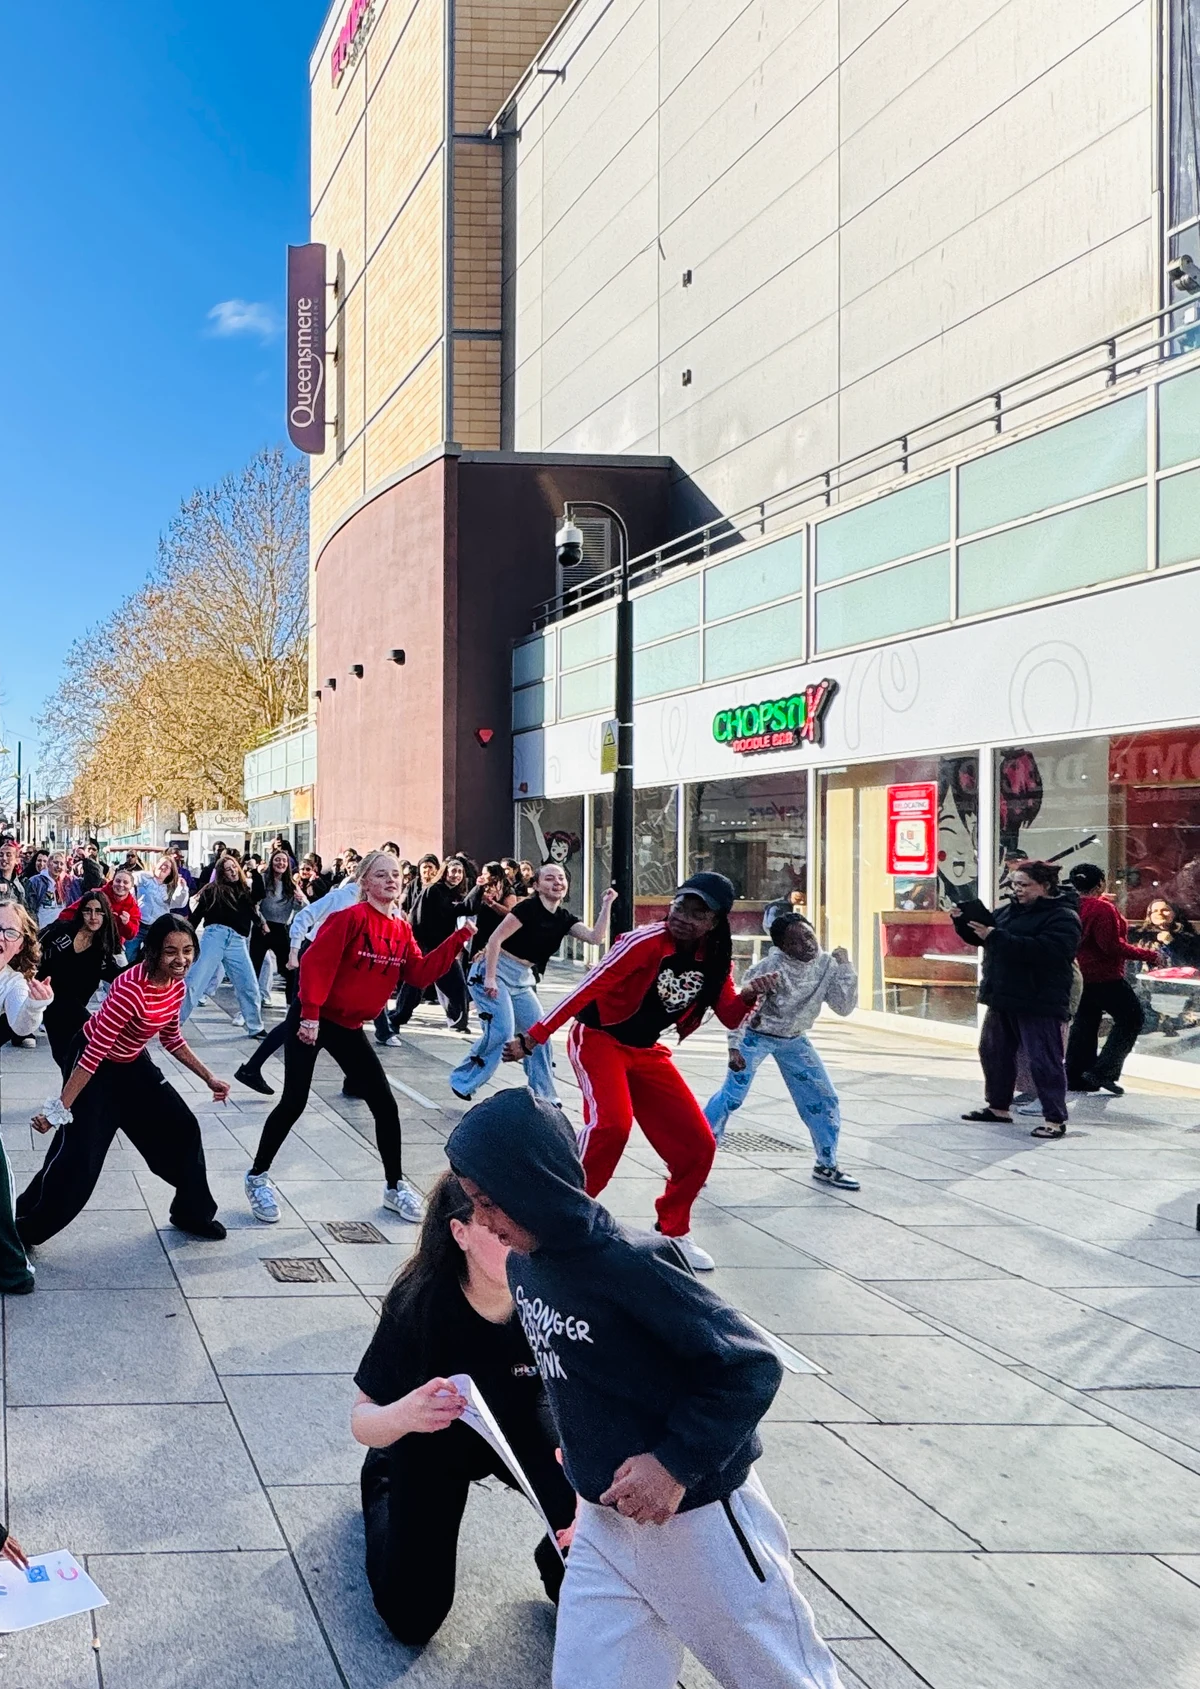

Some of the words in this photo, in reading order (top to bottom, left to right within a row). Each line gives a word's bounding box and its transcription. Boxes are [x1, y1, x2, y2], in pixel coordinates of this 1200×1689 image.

[290, 297, 322, 428] Queensmere
[733, 737, 771, 752] NOODLE
[516, 1285, 594, 1344] STRONGER
